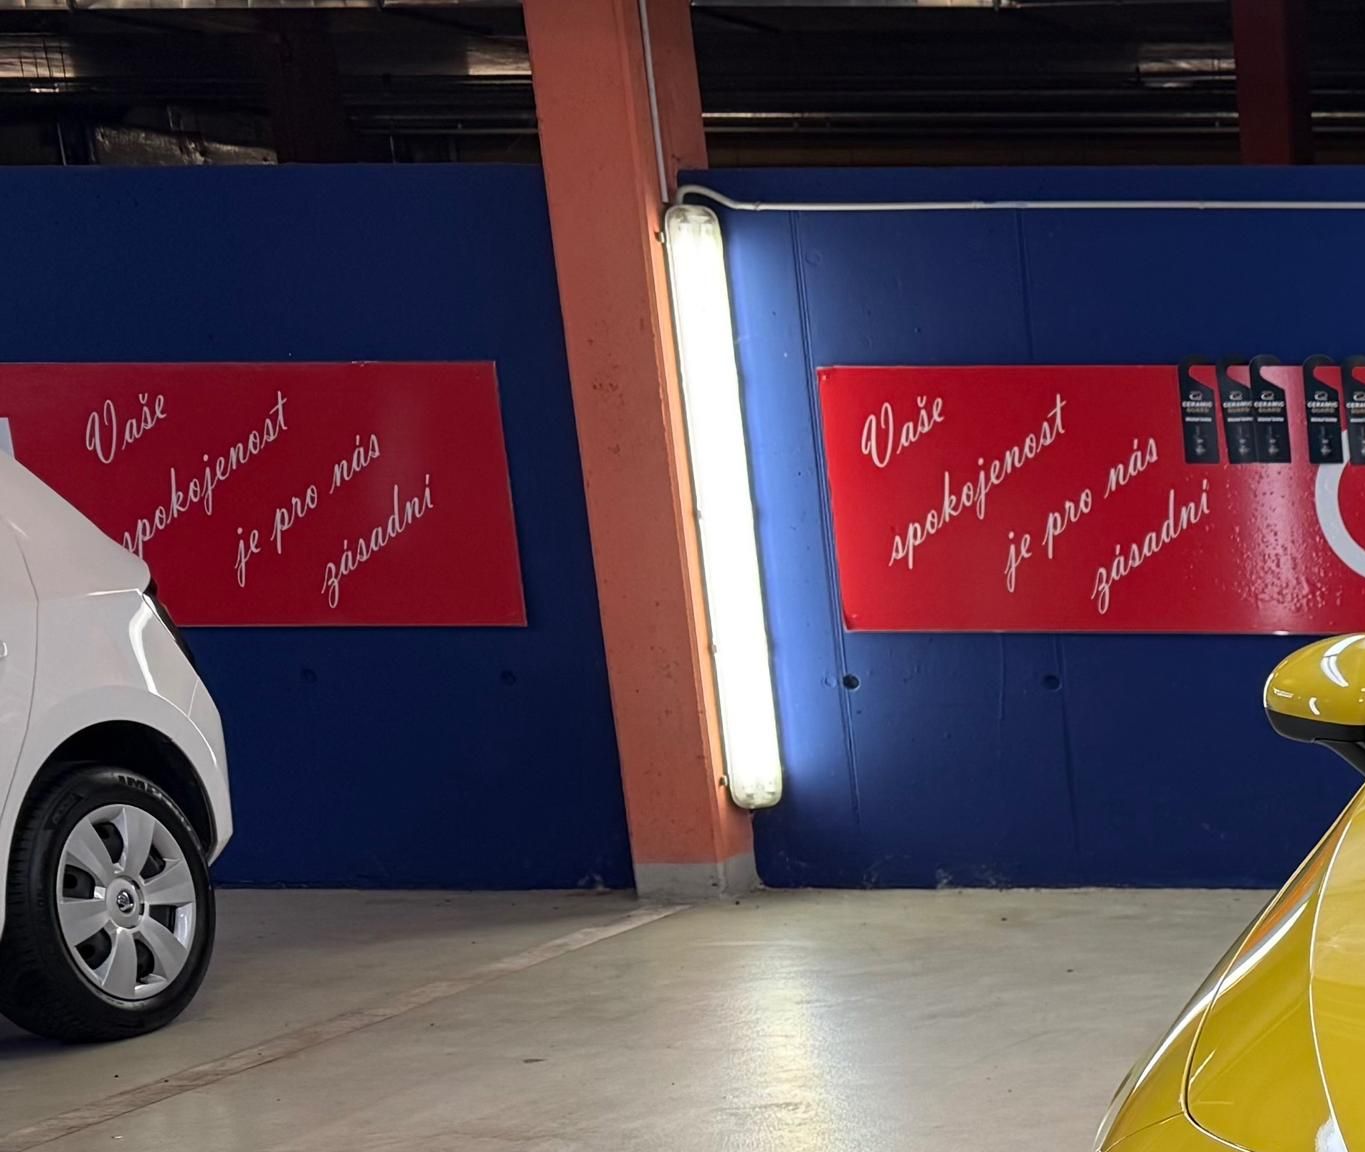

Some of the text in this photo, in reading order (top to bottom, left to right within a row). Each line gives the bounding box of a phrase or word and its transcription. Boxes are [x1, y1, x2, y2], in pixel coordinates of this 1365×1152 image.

[86, 393, 167, 464] Vaše
[121, 390, 289, 558] spokojenost
[861, 396, 943, 468] Vaše
[889, 393, 1066, 570] spokojenost
[235, 433, 381, 587] je pro nás
[321, 474, 434, 609] zásadní
[1005, 438, 1158, 593] je pro nás
[1091, 479, 1210, 614] zásadní
